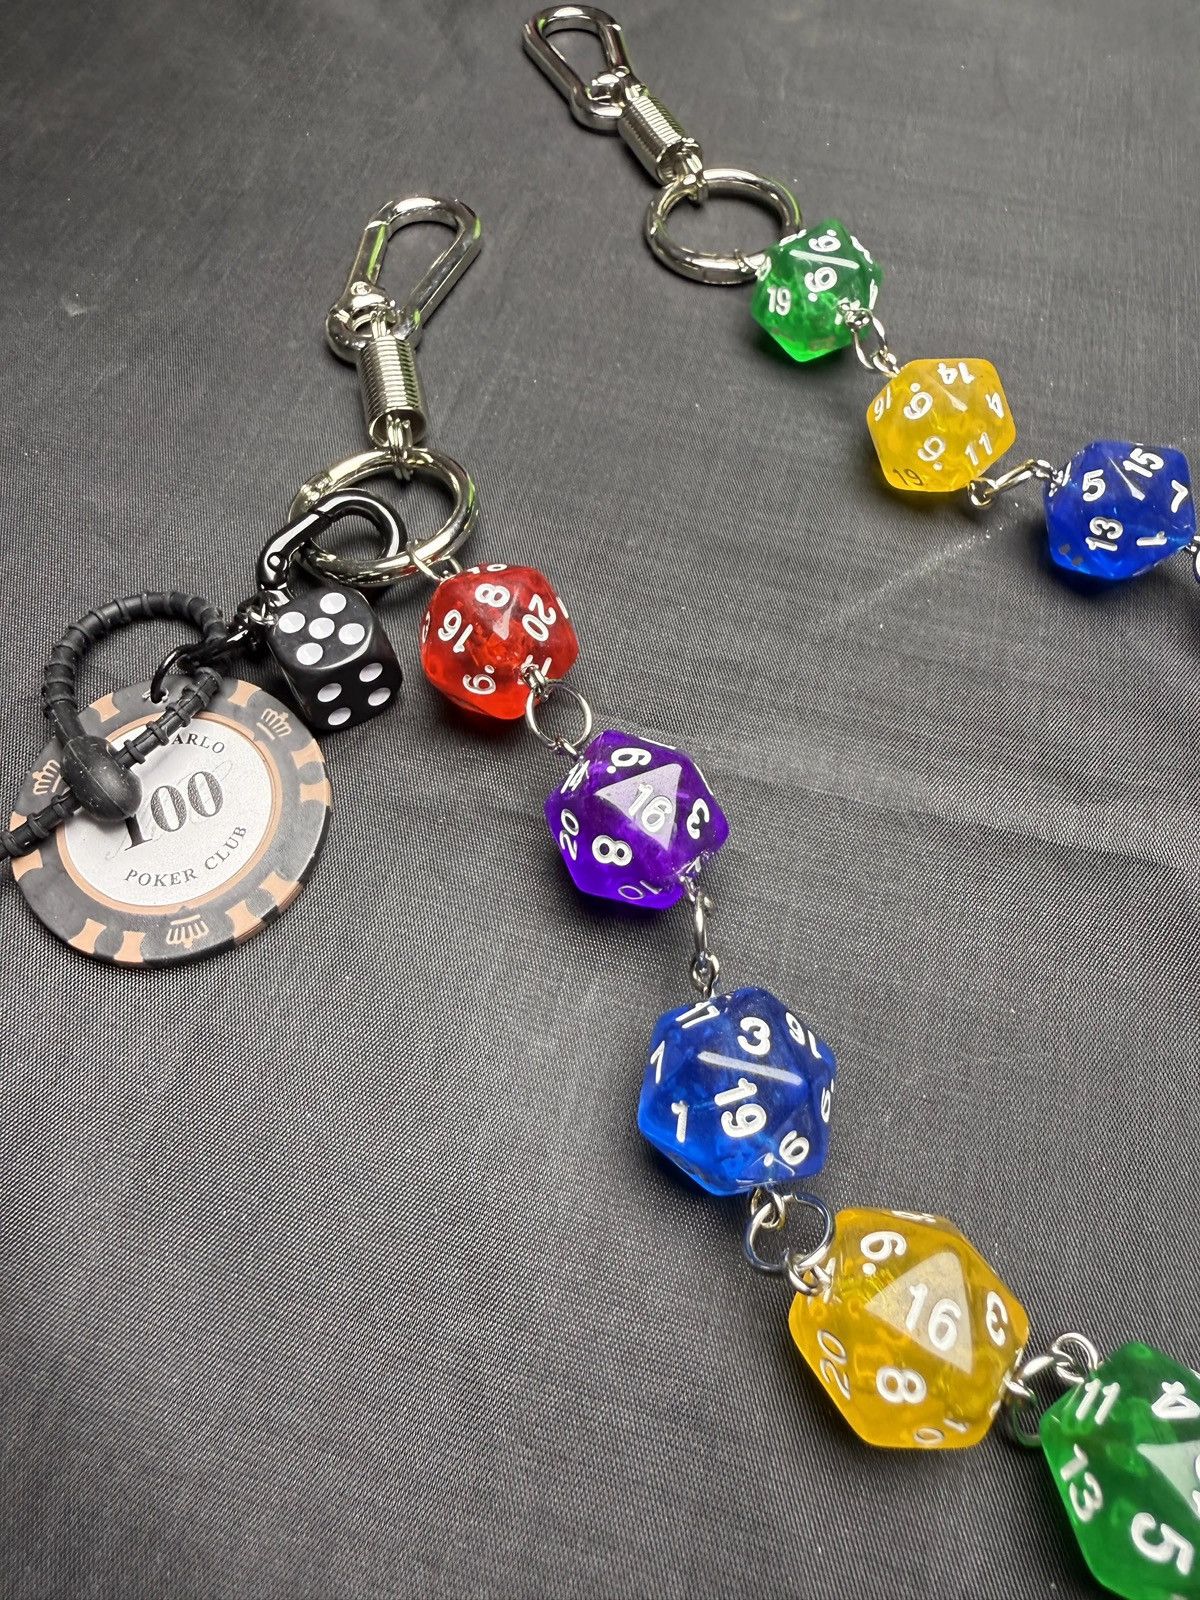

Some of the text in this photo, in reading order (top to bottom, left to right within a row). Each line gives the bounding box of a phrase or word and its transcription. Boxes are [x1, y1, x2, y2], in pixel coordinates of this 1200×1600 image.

[767, 286, 792, 316] 19
[937, 361, 976, 385] 14
[985, 391, 1005, 419] 4
[965, 431, 993, 466] 11
[1123, 448, 1164, 478] 15
[893, 468, 924, 486] 19
[1083, 469, 1107, 502] 5
[1171, 480, 1189, 513] 7
[1085, 517, 1124, 551] 13
[1136, 531, 1168, 547] 1
[474, 583, 511, 608] 8
[437, 609, 474, 653] 16
[521, 594, 557, 642] 20
[171, 733, 225, 754] ARLO
[628, 783, 673, 833] 16
[686, 798, 710, 840] 3
[559, 809, 580, 861] 20
[591, 835, 633, 867] 8
[125, 826, 248, 888] POKER CLUB
[618, 880, 663, 900] 10
[675, 1001, 720, 1029] 17
[737, 1017, 771, 1055] 3
[671, 1100, 689, 1144] 1
[714, 1078, 767, 1138] 19
[905, 1283, 962, 1351] 16
[986, 1291, 1008, 1346] 3
[817, 1329, 850, 1400] 20
[876, 1366, 927, 1404] 8
[1075, 1378, 1120, 1425] 11
[1151, 1381, 1200, 1419] 4
[914, 1418, 969, 1444] 10
[1060, 1443, 1104, 1523] 13
[1130, 1512, 1194, 1576] 5
